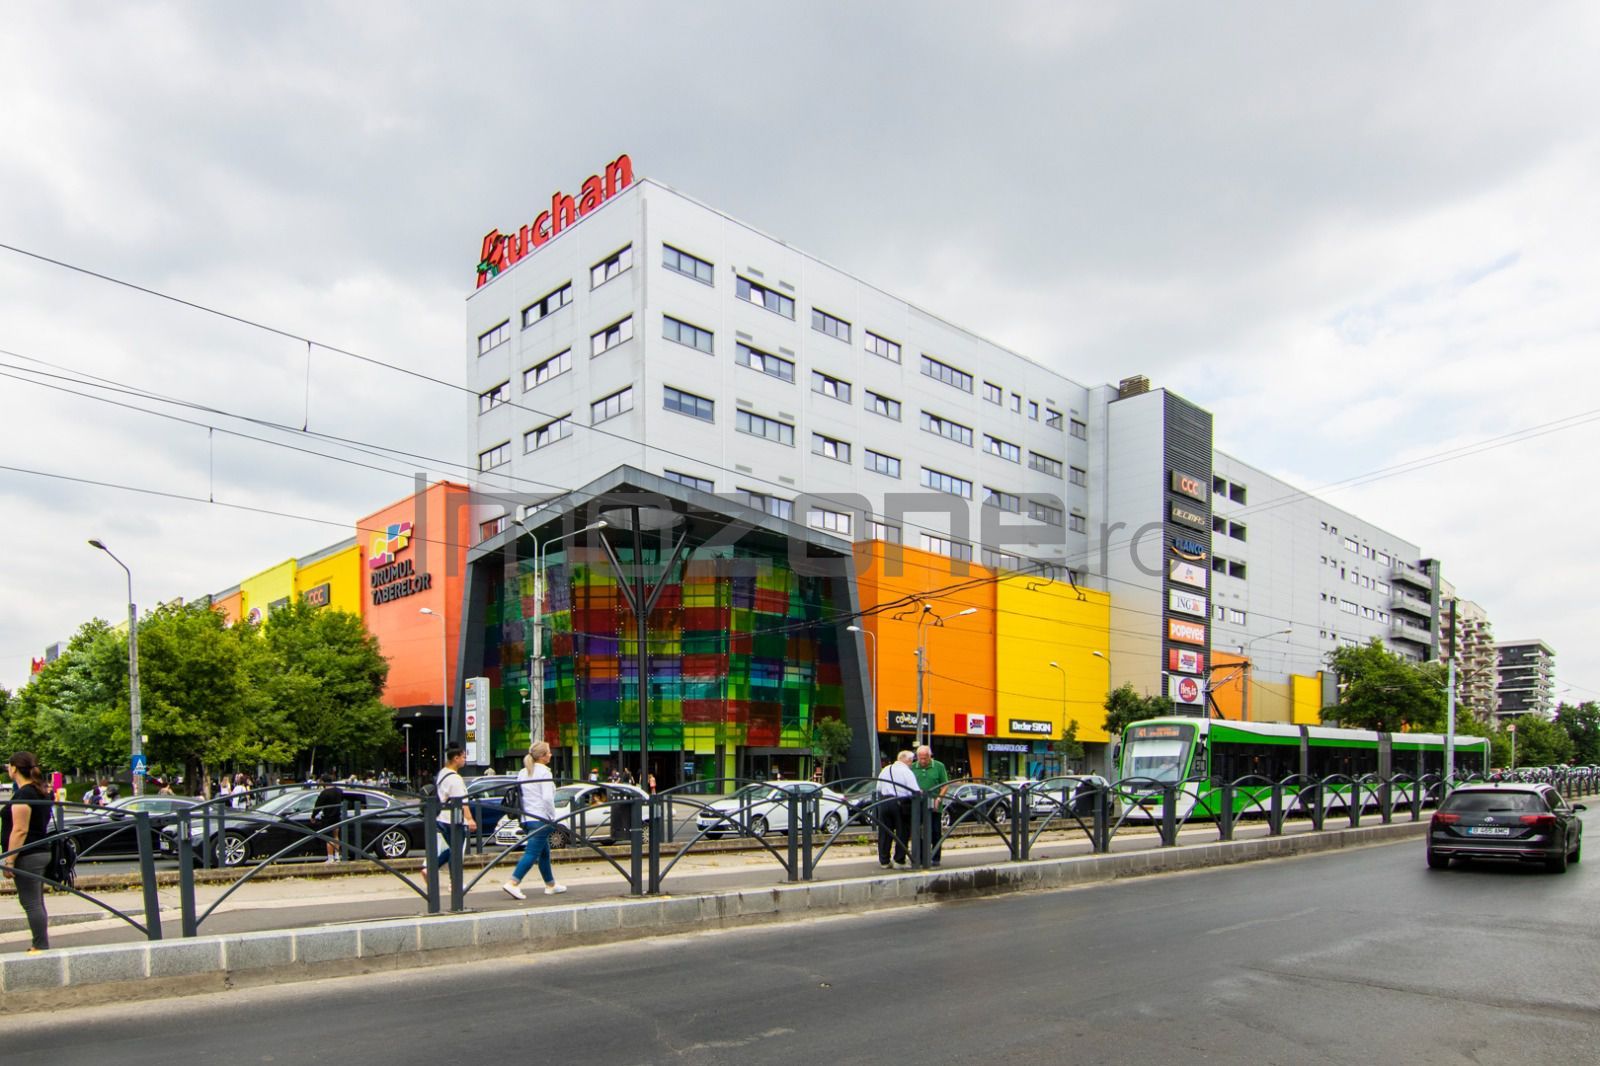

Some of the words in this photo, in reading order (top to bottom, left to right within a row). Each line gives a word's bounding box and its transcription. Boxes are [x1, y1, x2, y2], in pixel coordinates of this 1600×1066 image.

[477, 154, 633, 288] Auchan
[1181, 478, 1199, 496] CCC
[1172, 537, 1204, 555] FLANCO
[371, 559, 414, 588] DRUMUL
[308, 589, 324, 605] CCC
[371, 573, 432, 606] TABERELOR
[1177, 596, 1191, 610] ING
